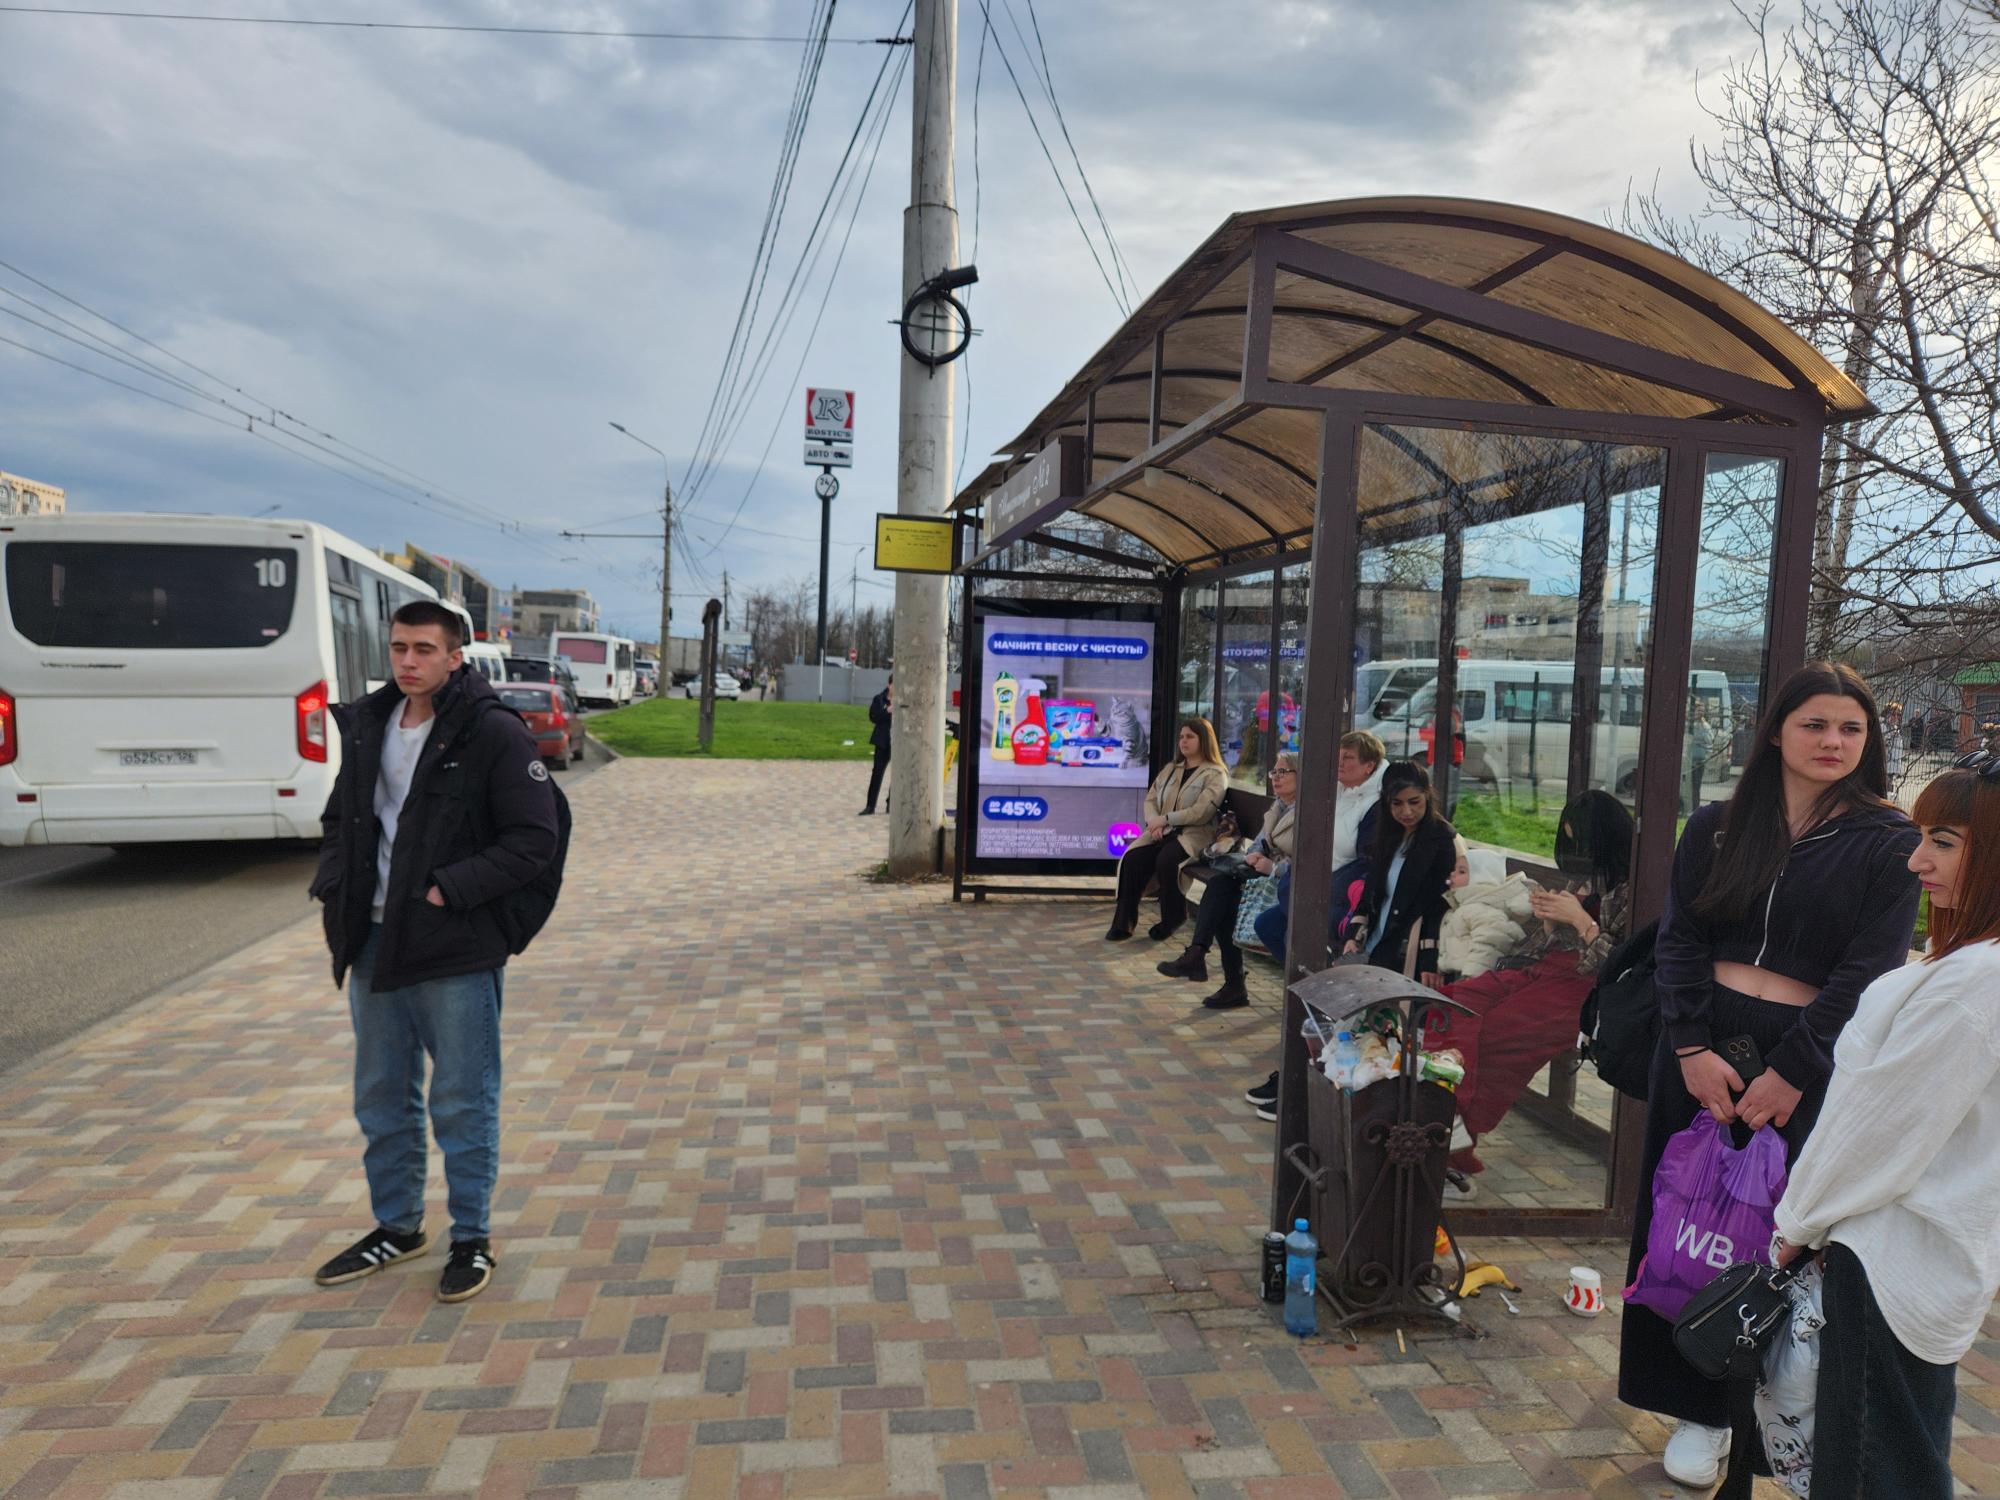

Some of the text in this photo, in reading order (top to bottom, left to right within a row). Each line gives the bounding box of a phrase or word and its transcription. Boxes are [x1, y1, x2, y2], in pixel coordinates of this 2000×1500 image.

[807, 449, 830, 458] АВТО
[254, 558, 286, 588] 10
[993, 640, 1143, 654] НАЧНИТЕ ВЕСНУ С ЧИСТОТЫ!
[1675, 1217, 1734, 1270] WB
